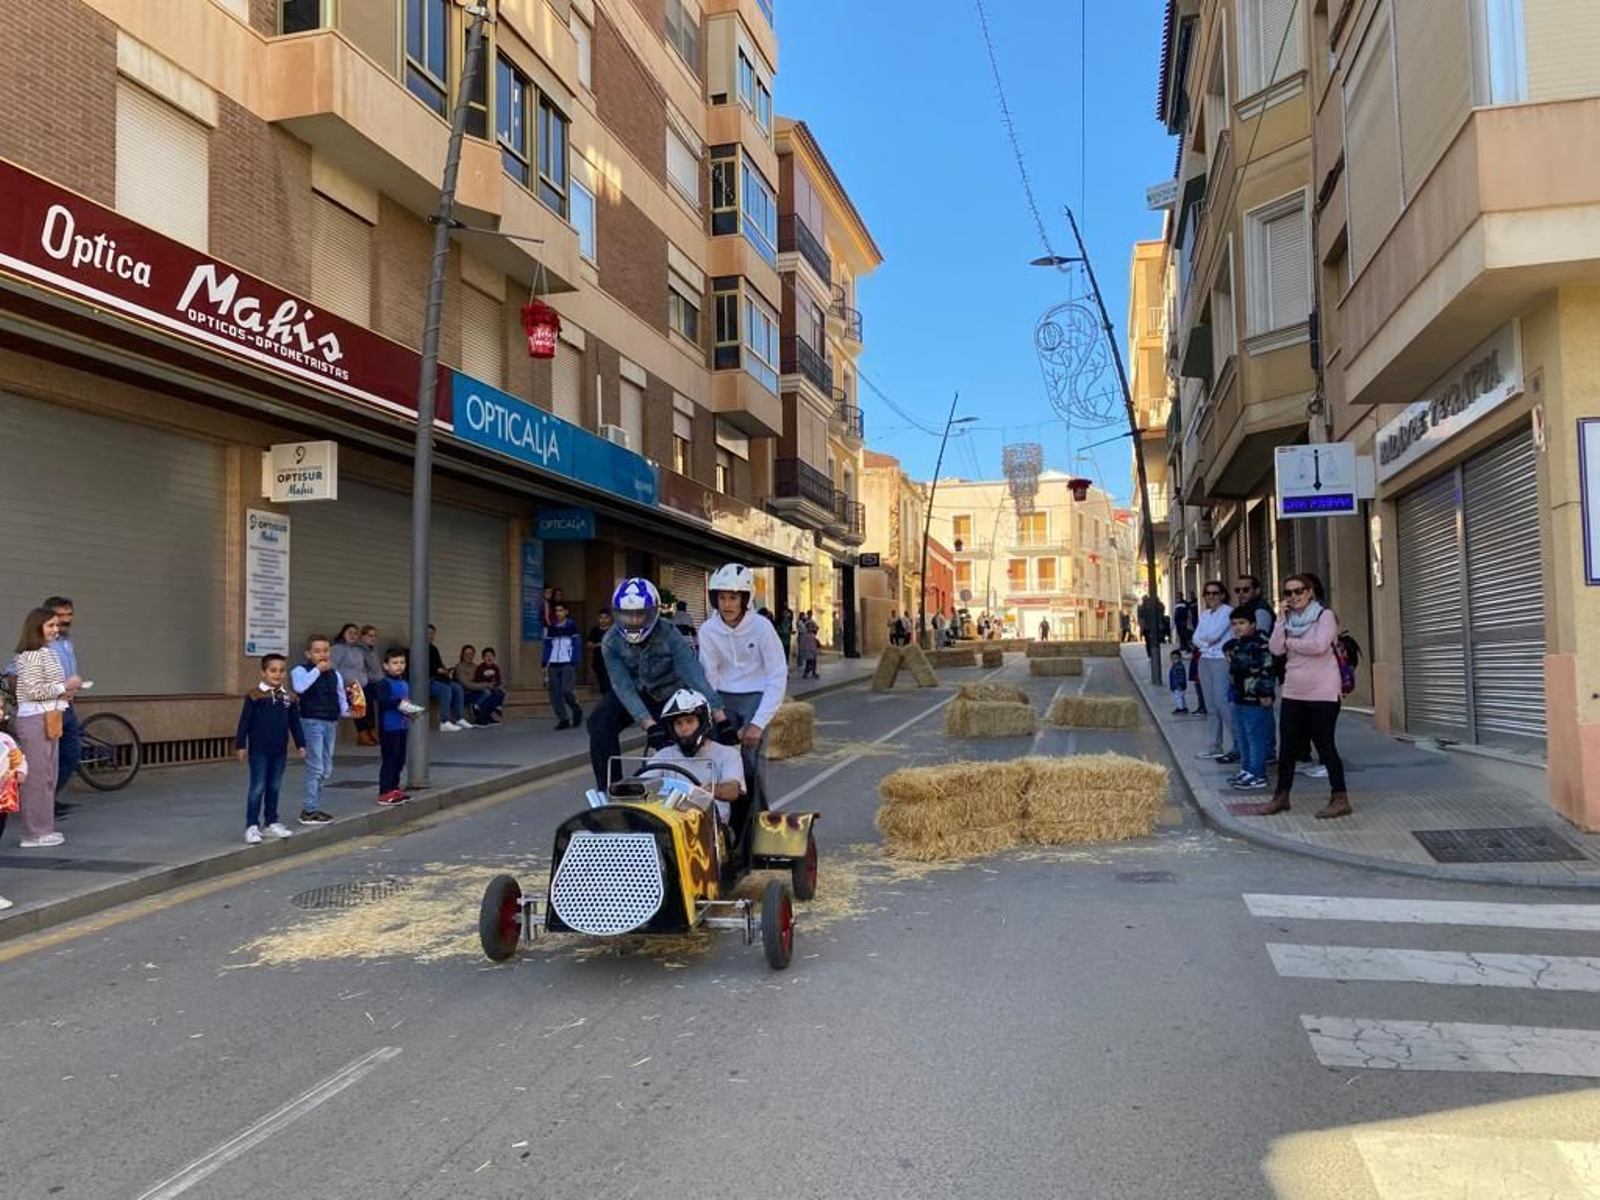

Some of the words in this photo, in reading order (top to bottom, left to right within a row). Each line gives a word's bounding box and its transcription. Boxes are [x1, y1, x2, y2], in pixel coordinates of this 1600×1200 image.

[41, 204, 151, 288] Optica
[176, 264, 343, 363] Mahis
[187, 308, 350, 381] OPTICOS-OPTOMETRISTAS
[277, 471, 323, 484] OPTISUR
